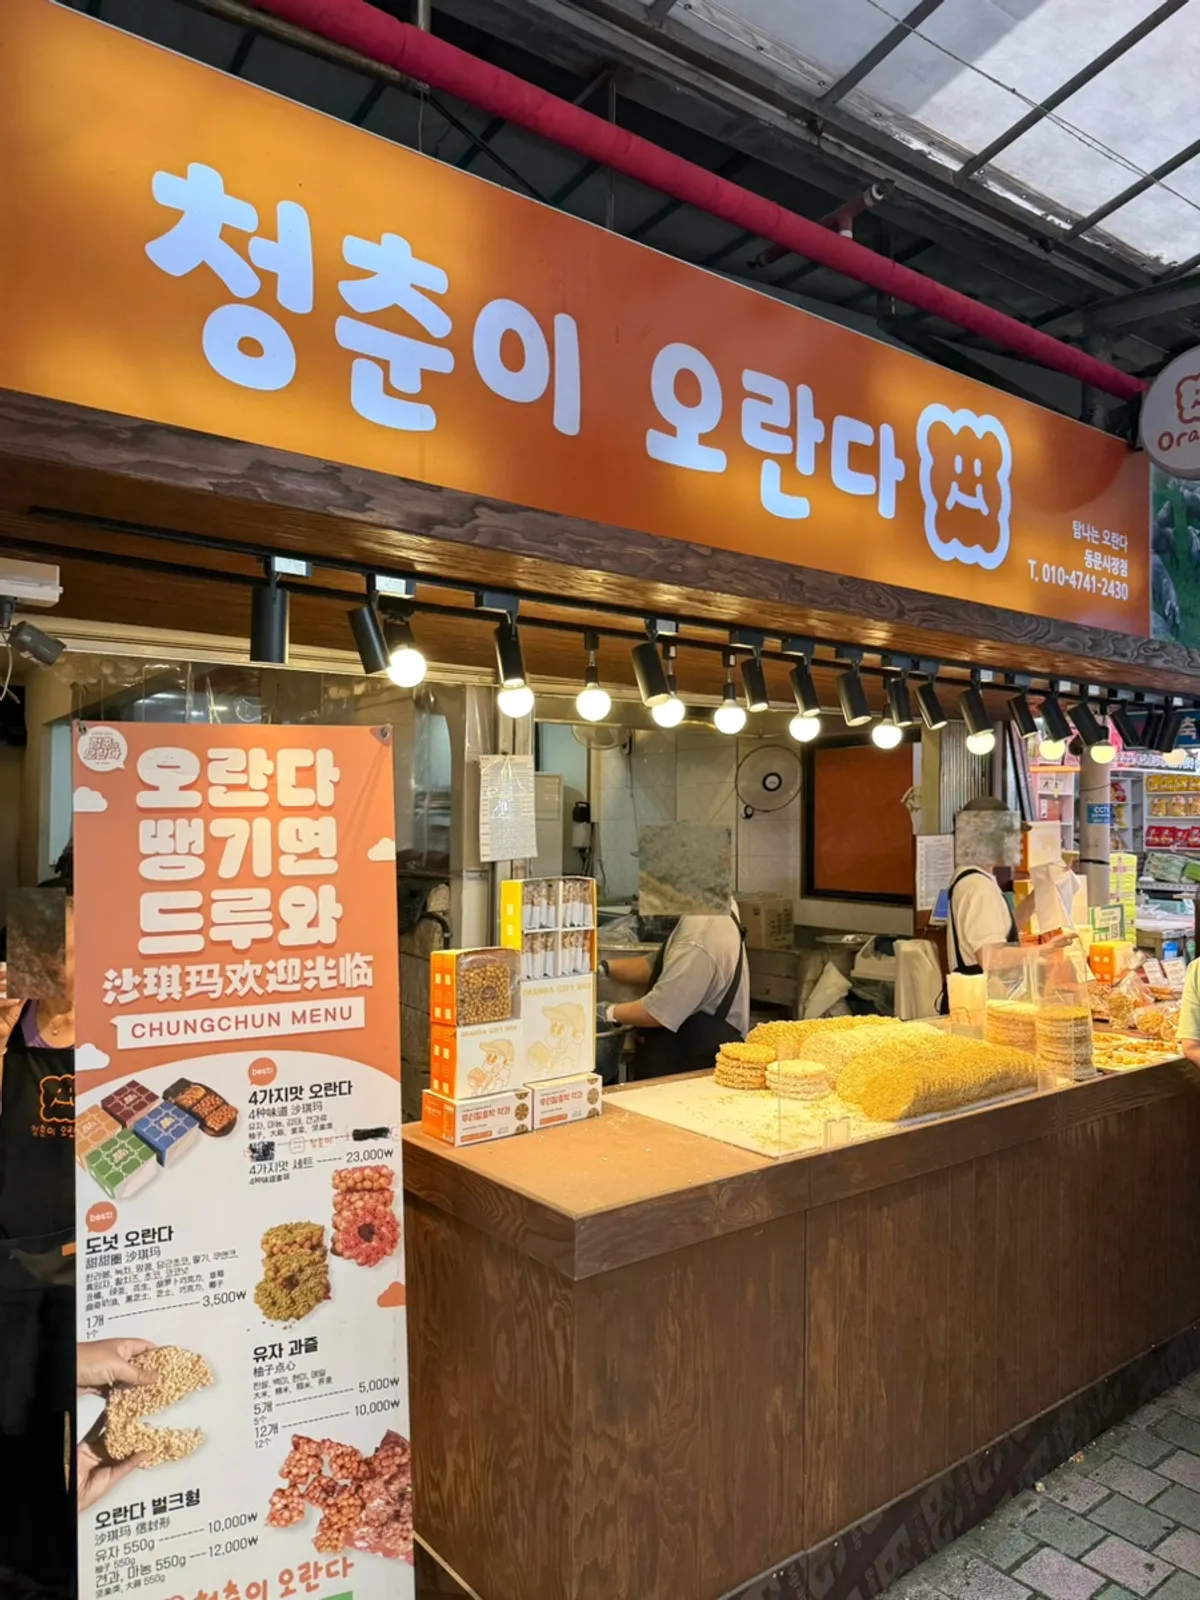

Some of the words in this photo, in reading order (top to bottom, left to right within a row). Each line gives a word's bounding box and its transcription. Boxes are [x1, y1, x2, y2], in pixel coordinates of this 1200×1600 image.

[145, 163, 580, 435] 청춘이
[646, 343, 905, 518] 오란다
[1072, 520, 1100, 545] 탐나는
[1028, 559, 1039, 582] T.
[1042, 564, 1128, 600] 010-4741-2430
[1084, 549, 1128, 577] 동문시장점
[136, 747, 341, 809] 오란다
[138, 816, 339, 882] 땡기면
[138, 884, 343, 955] 드루와
[103, 952, 374, 1005] 沙琪玛欢迎光临
[131, 1012, 281, 1039] CHUNGCHUN
[291, 1005, 353, 1025] MENU
[248, 1085, 304, 1105] 4가지맛
[309, 1080, 353, 1099] 오란다
[248, 1106, 288, 1120] 4种味道
[291, 1101, 323, 1116] 沙琪玛
[249, 1161, 288, 1175] 4가지맛
[292, 1157, 313, 1170] 세트
[86, 1233, 119, 1255] 도넛
[124, 1225, 174, 1248] 오란다
[125, 1246, 161, 1264] 沙琪玛
[86, 1315, 105, 1329] 1개
[203, 1290, 247, 1307] 3,500₩
[253, 1343, 284, 1363] 유자
[288, 1336, 319, 1357] 과즐
[253, 1401, 273, 1416] 5개
[358, 1377, 400, 1393] 5,000₩
[254, 1423, 279, 1439] 12개
[354, 1400, 400, 1417] 10,000₩
[95, 1502, 146, 1531] 오란다
[152, 1488, 201, 1514] 벌크형
[94, 1525, 132, 1547] 沙琪玛
[95, 1545, 120, 1563] 유자
[123, 1538, 155, 1555] 550g
[208, 1512, 258, 1533] 10,000₩
[95, 1570, 124, 1588] 견과,
[155, 1554, 187, 1572] 550g
[208, 1536, 259, 1558] 12,000₩
[278, 1556, 355, 1598] 오란다
